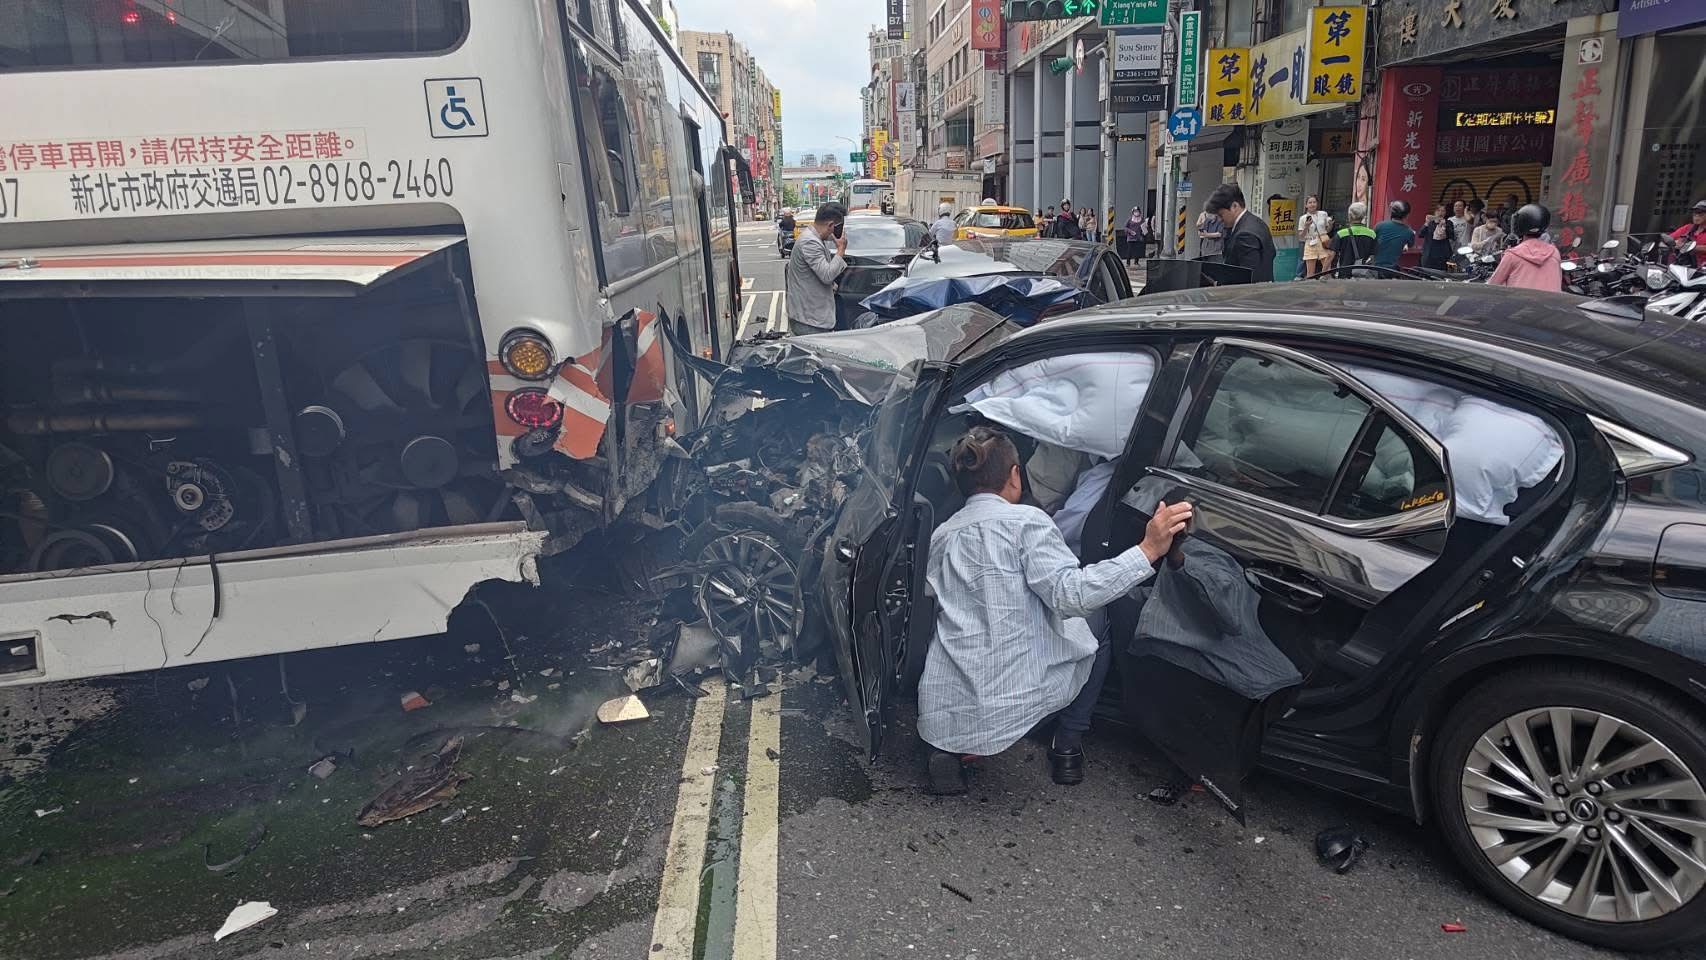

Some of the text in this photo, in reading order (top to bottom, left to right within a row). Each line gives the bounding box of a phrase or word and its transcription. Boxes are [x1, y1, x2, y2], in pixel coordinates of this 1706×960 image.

[1401, 110, 1424, 192] 新光證券
[1556, 67, 1602, 258] 正聲廣播公
[1273, 206, 1294, 224] 租
